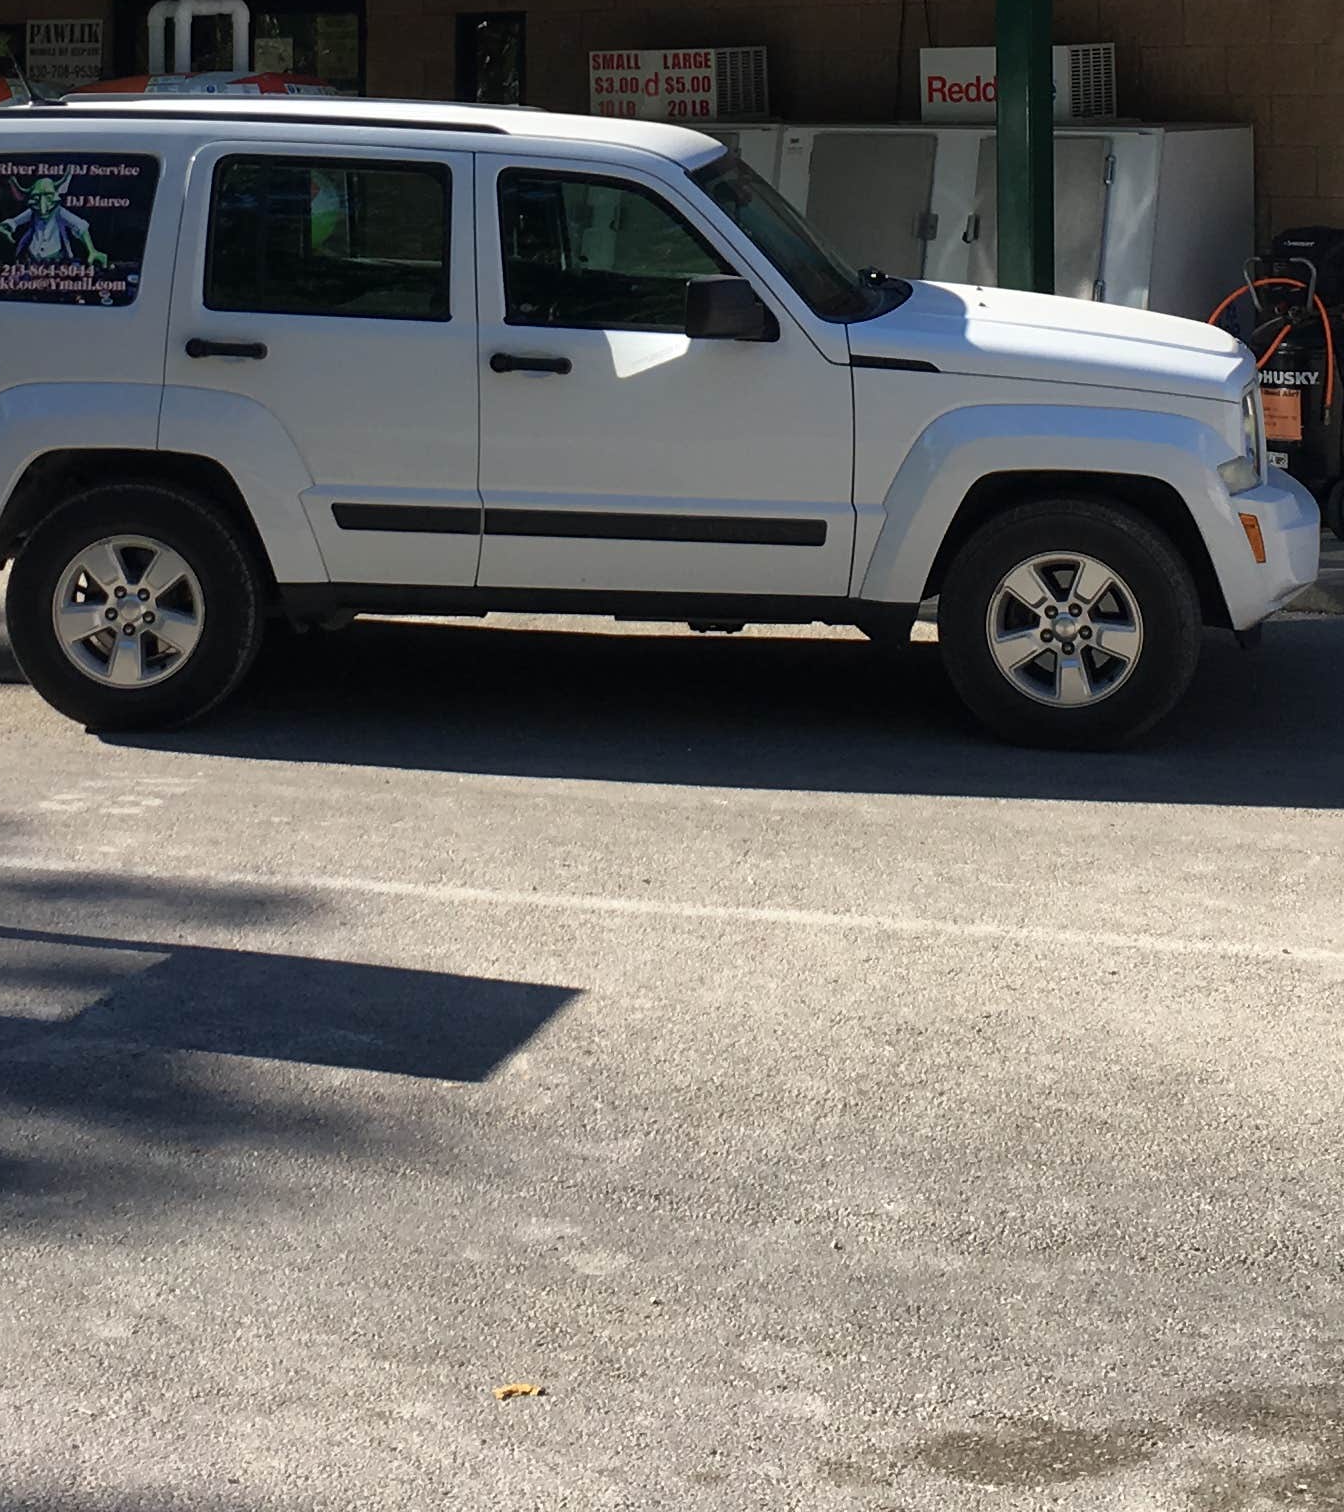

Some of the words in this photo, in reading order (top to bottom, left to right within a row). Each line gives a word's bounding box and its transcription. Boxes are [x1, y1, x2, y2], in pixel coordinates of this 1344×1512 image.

[29, 23, 100, 44] PAWLIK
[591, 53, 641, 70] SMALL
[663, 52, 712, 70] LARGE
[594, 76, 640, 94] $3.00
[664, 75, 712, 94] $5.00
[927, 75, 998, 104] Redd
[667, 100, 688, 117] 20
[691, 99, 711, 117] LB
[89, 163, 140, 177] Service
[66, 196, 84, 207] DJ
[87, 196, 130, 208] Marco
[1263, 369, 1319, 385] HUSKY
